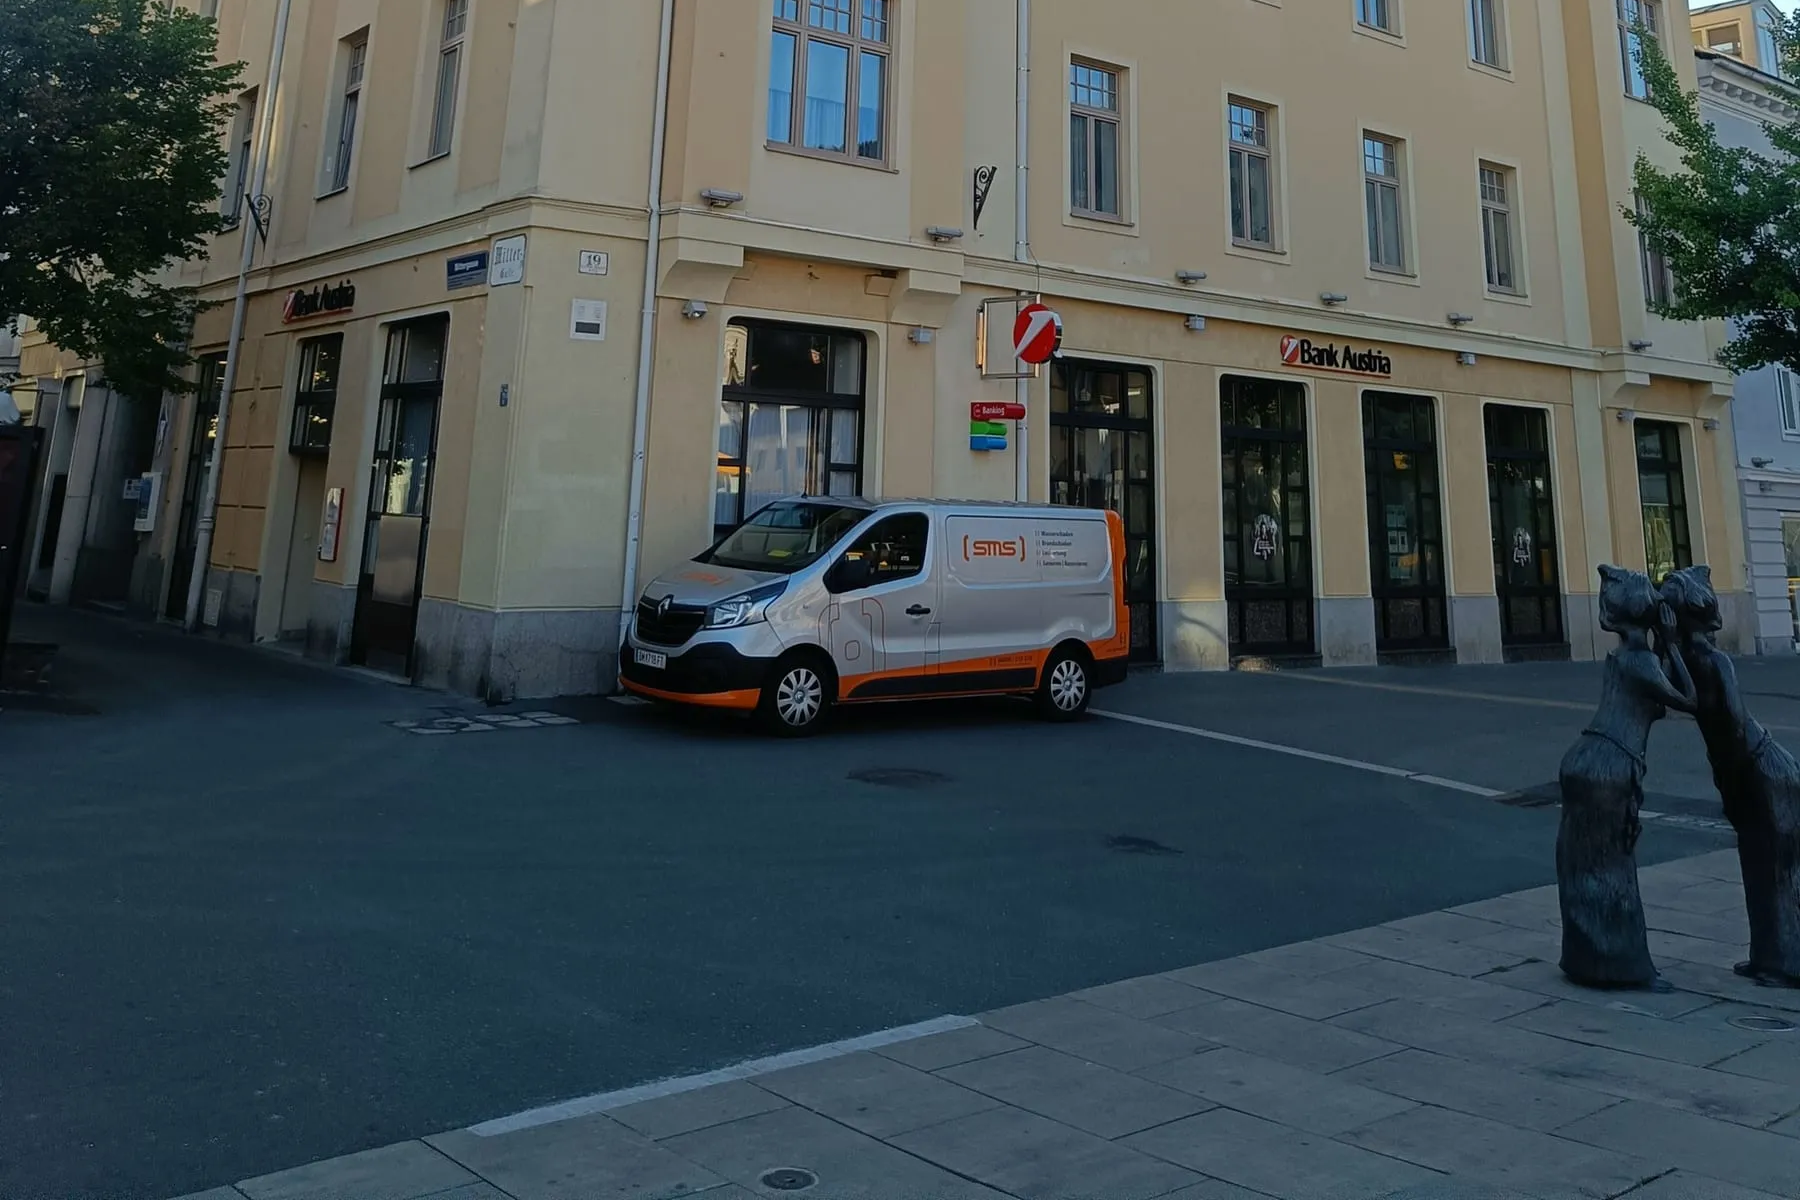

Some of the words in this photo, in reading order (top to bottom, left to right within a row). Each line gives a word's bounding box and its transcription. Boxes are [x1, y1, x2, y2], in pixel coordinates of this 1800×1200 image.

[587, 254, 601, 266] 19
[1300, 338, 1339, 368] Bank
[1341, 345, 1391, 374] Austria
[982, 404, 1005, 416] Banking
